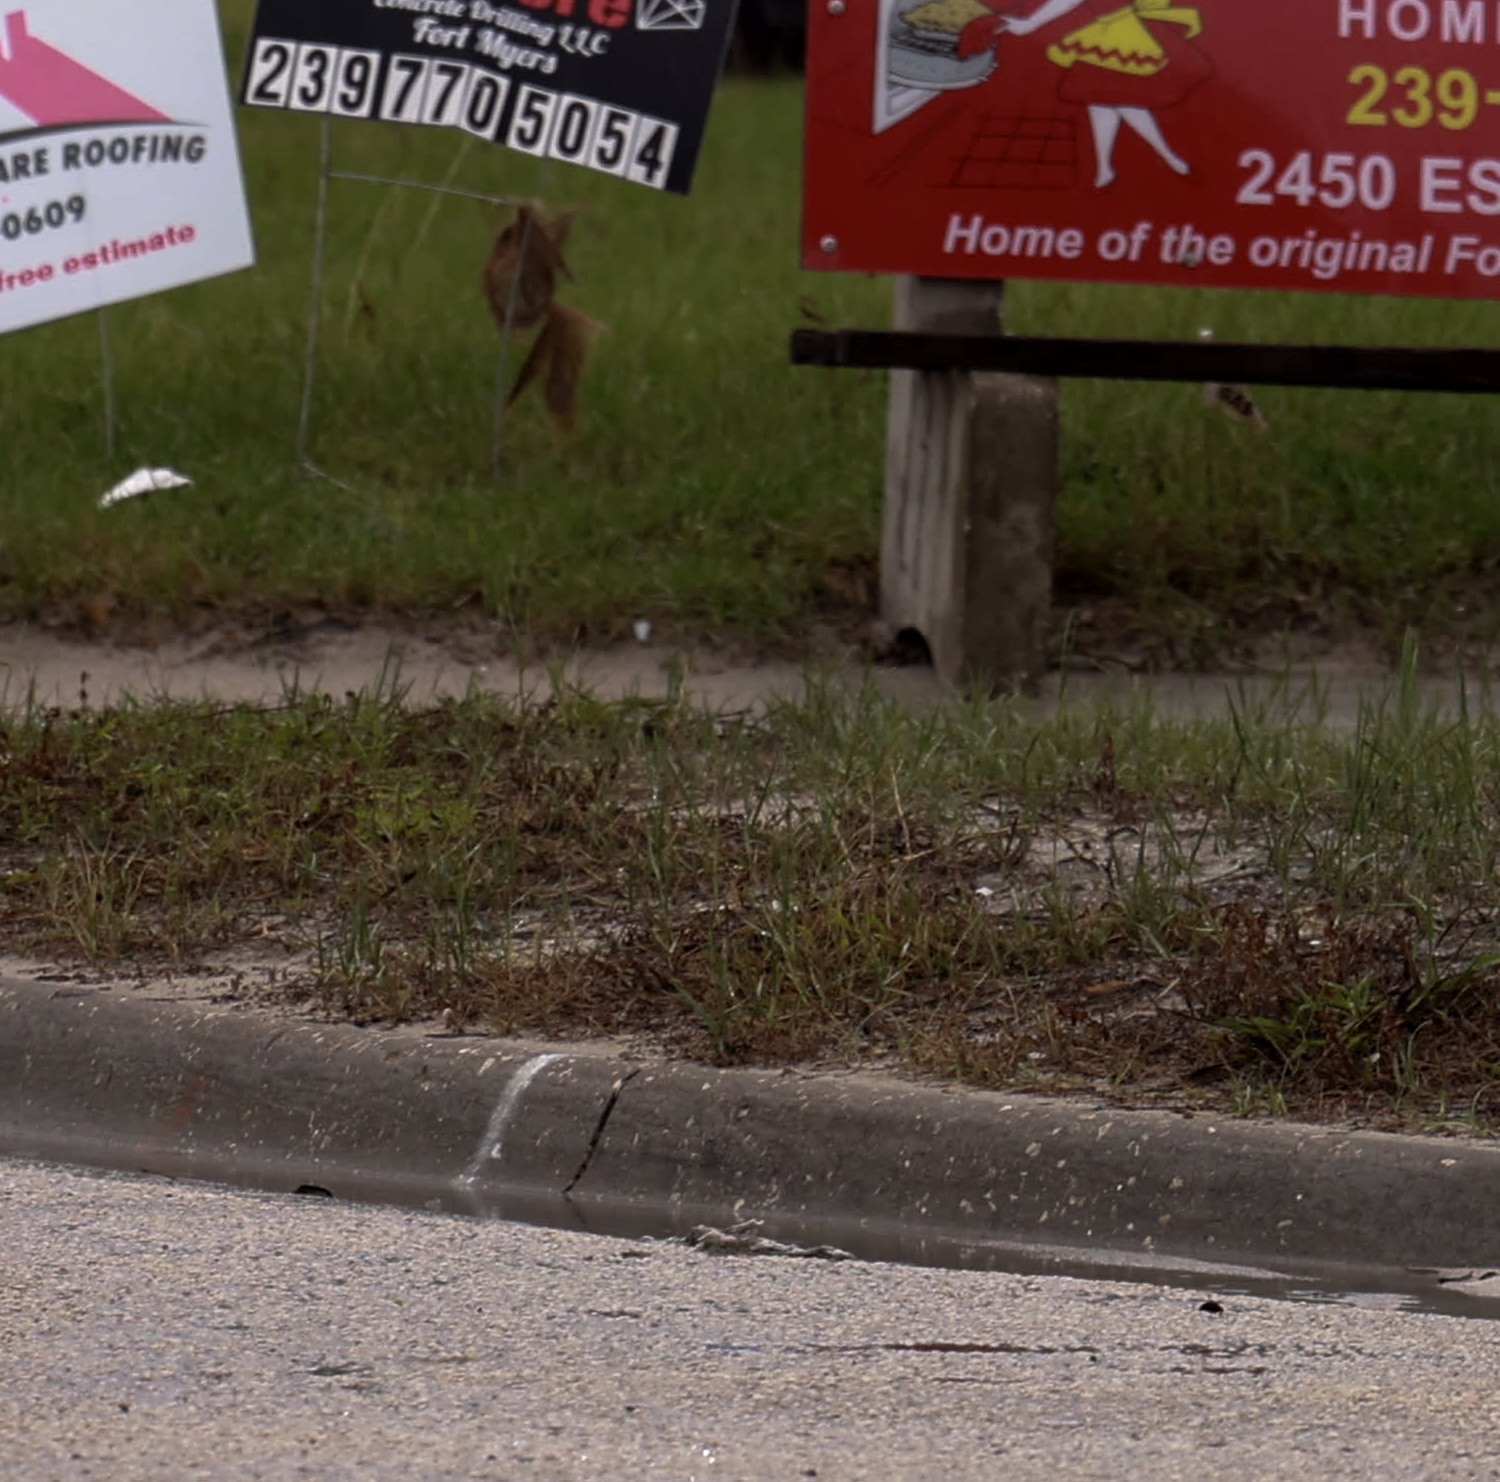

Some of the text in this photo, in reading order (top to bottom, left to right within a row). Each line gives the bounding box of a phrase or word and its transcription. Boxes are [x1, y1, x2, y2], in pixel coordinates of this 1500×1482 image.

[412, 17, 560, 76] Fort Myers
[558, 24, 612, 58] LLC
[250, 42, 672, 186] 239 770 5054
[62, 132, 207, 172] ROOFING
[1236, 148, 1396, 212] 2450
[62, 220, 197, 276] estimate
[943, 215, 1084, 261] Home
[1099, 222, 1153, 262] of
[1160, 222, 1237, 266] the
[1253, 231, 1432, 281] original
